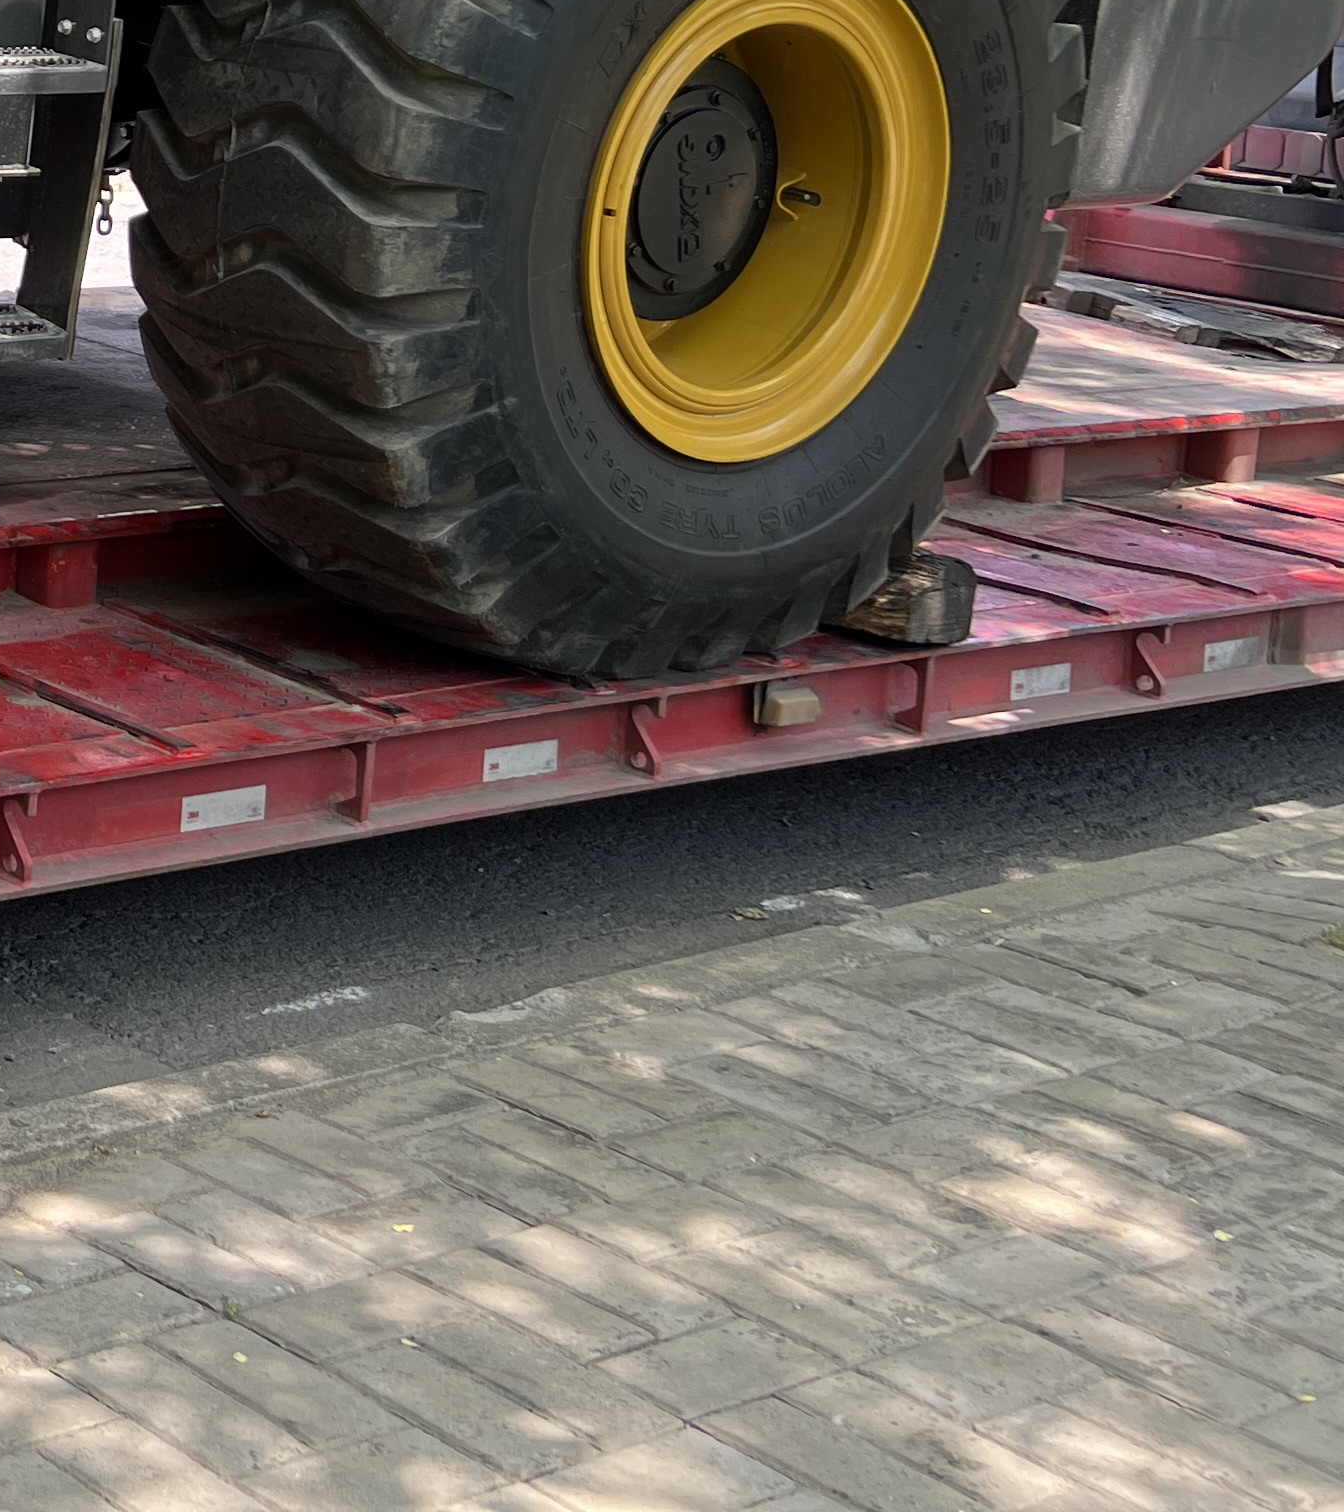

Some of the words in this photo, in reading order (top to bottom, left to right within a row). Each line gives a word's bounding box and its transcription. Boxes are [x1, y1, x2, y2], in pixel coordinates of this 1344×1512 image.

[676, 132, 701, 230] XCMG
[972, 28, 1011, 244] 23.5-25
[659, 500, 741, 540] TYRE
[757, 432, 888, 535] AEOLUS
